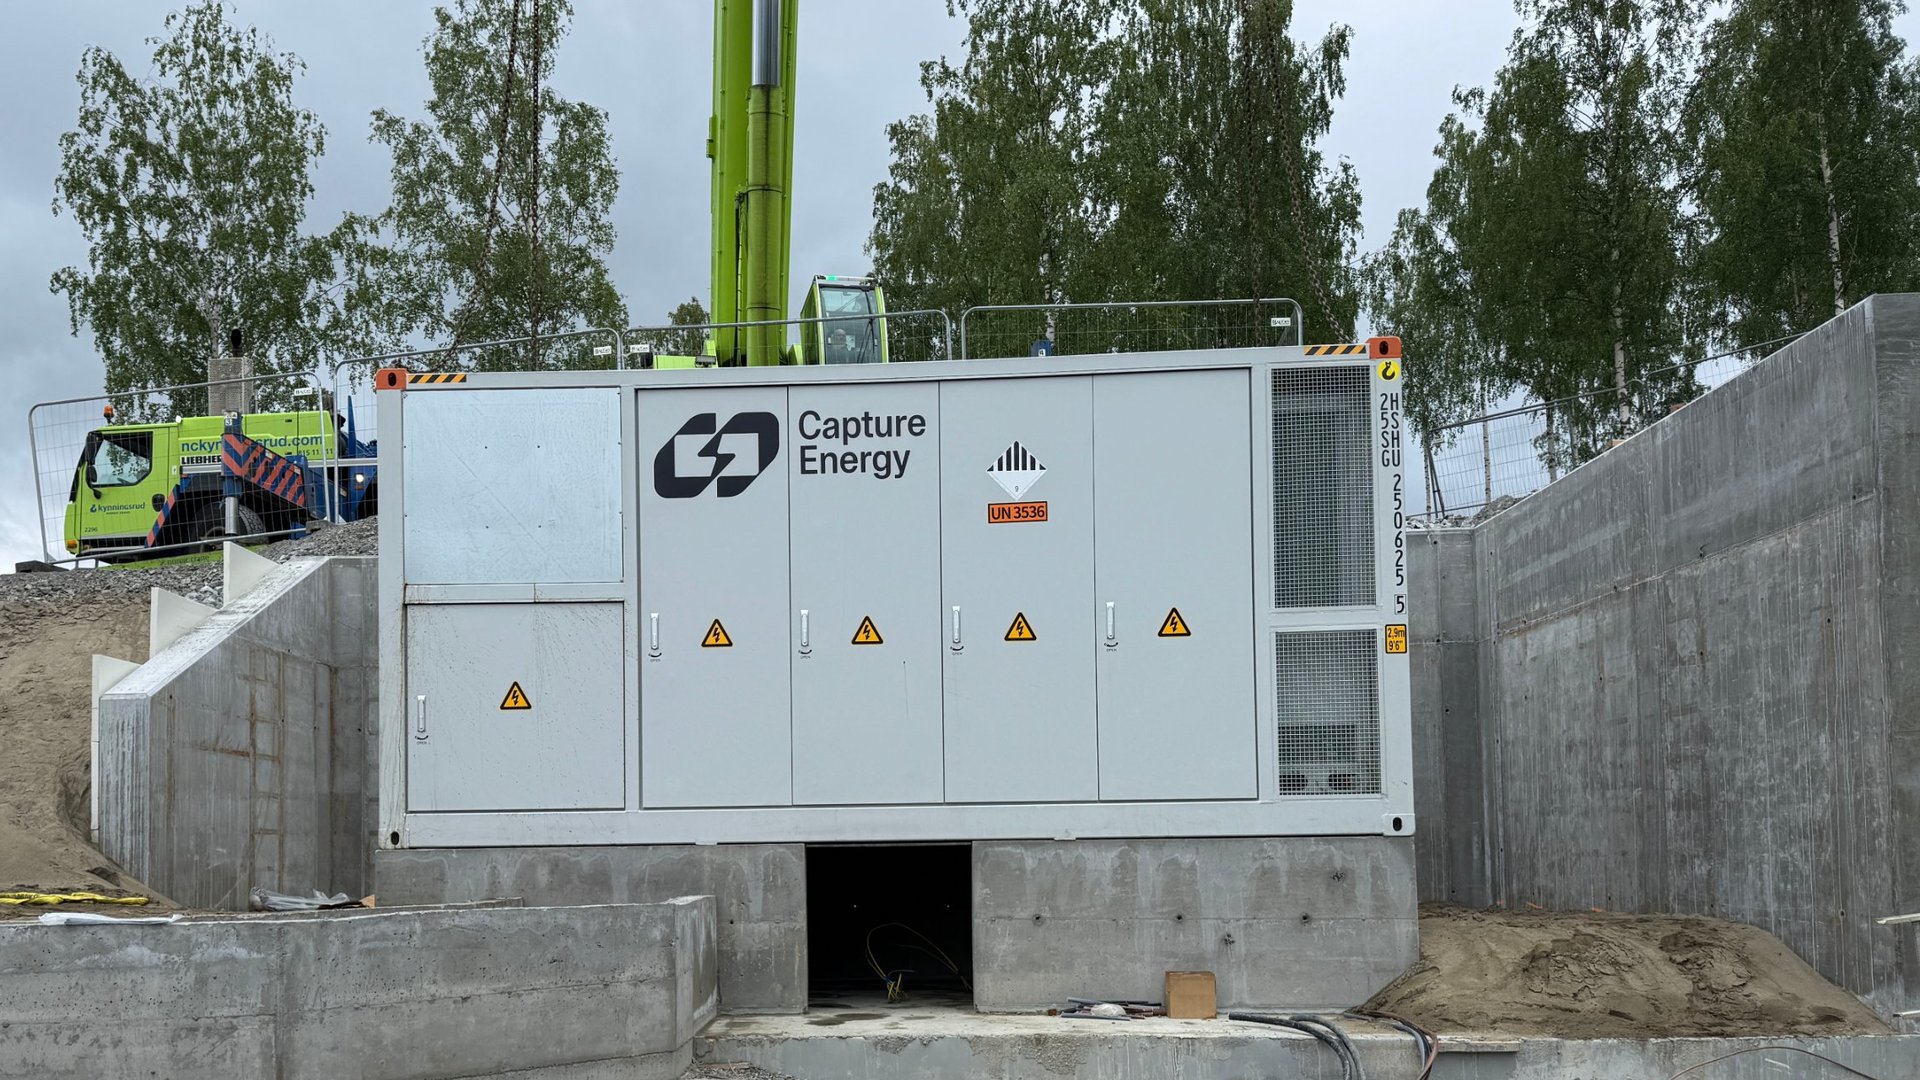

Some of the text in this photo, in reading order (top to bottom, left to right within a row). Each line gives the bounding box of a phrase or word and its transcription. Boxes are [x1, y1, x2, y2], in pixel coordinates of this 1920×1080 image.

[798, 410, 926, 446] Capture
[800, 445, 911, 480] Energy
[991, 505, 1046, 520] UN 3536
[1396, 595, 1405, 613] 5
